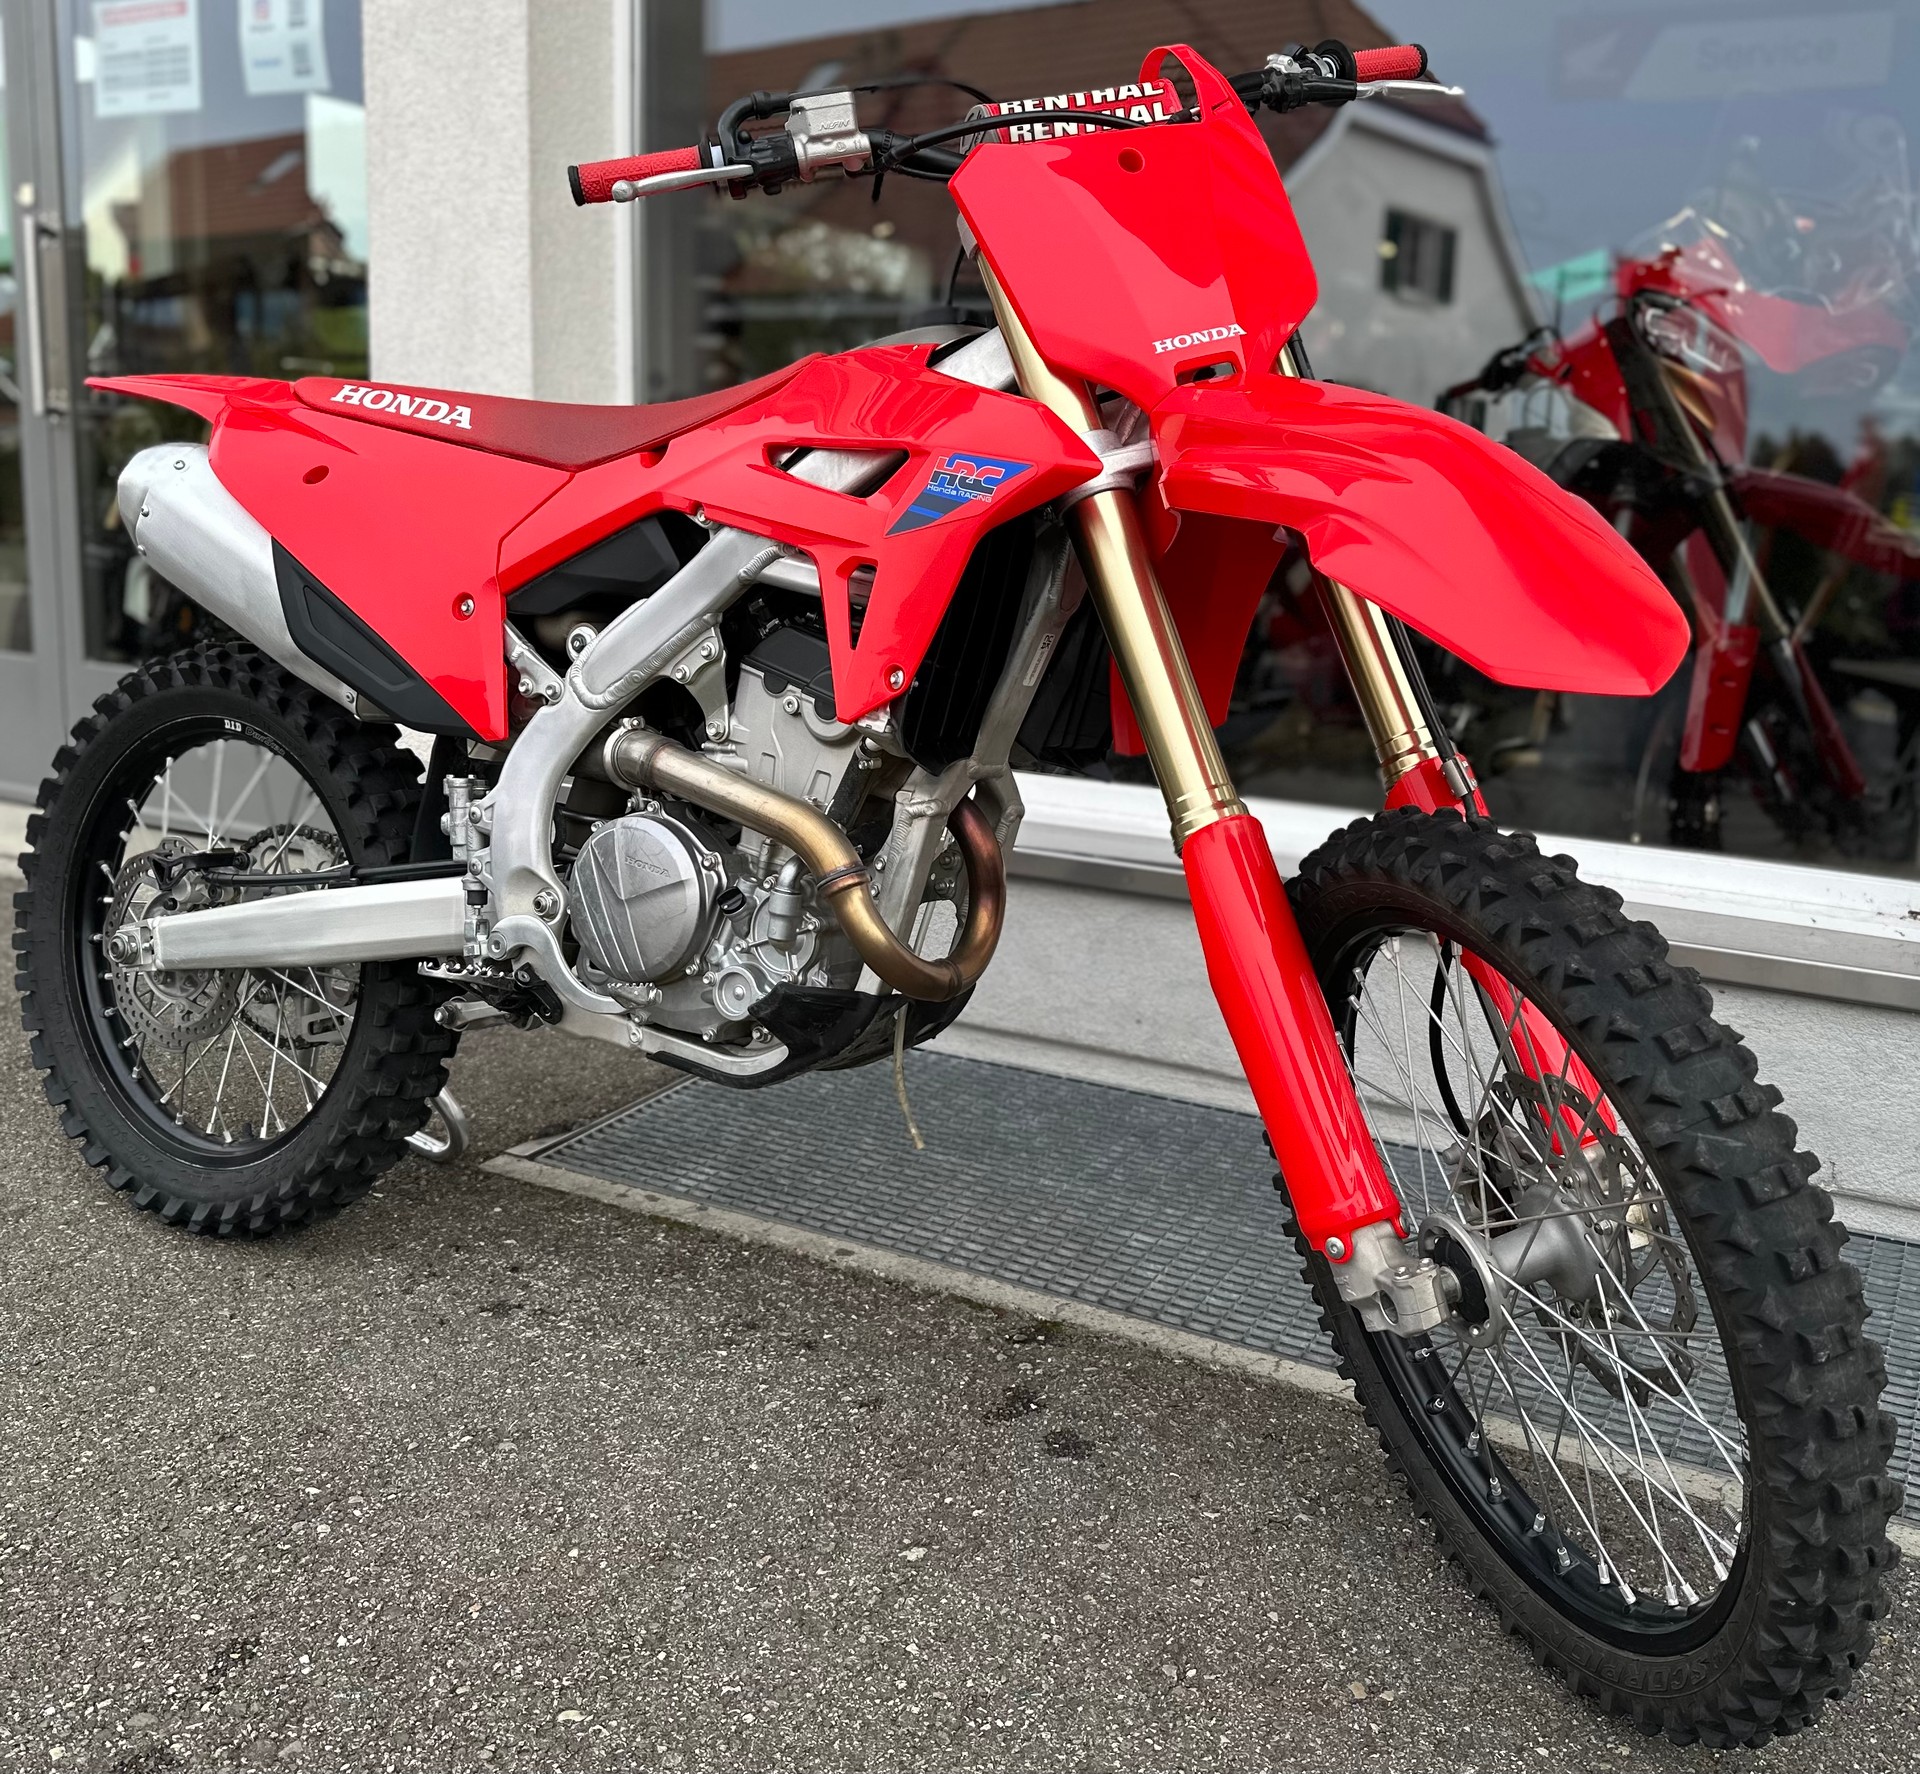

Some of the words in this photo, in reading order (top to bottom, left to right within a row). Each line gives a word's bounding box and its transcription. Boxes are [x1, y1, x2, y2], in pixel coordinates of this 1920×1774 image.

[998, 82, 1164, 115] RENTHAL
[1152, 323, 1247, 354] HONDA
[330, 384, 472, 430] HONDA
[928, 456, 1005, 497] HRC
[927, 484, 956, 496] Honda
[957, 490, 992, 503] RACING
[625, 855, 671, 879] HONDA
